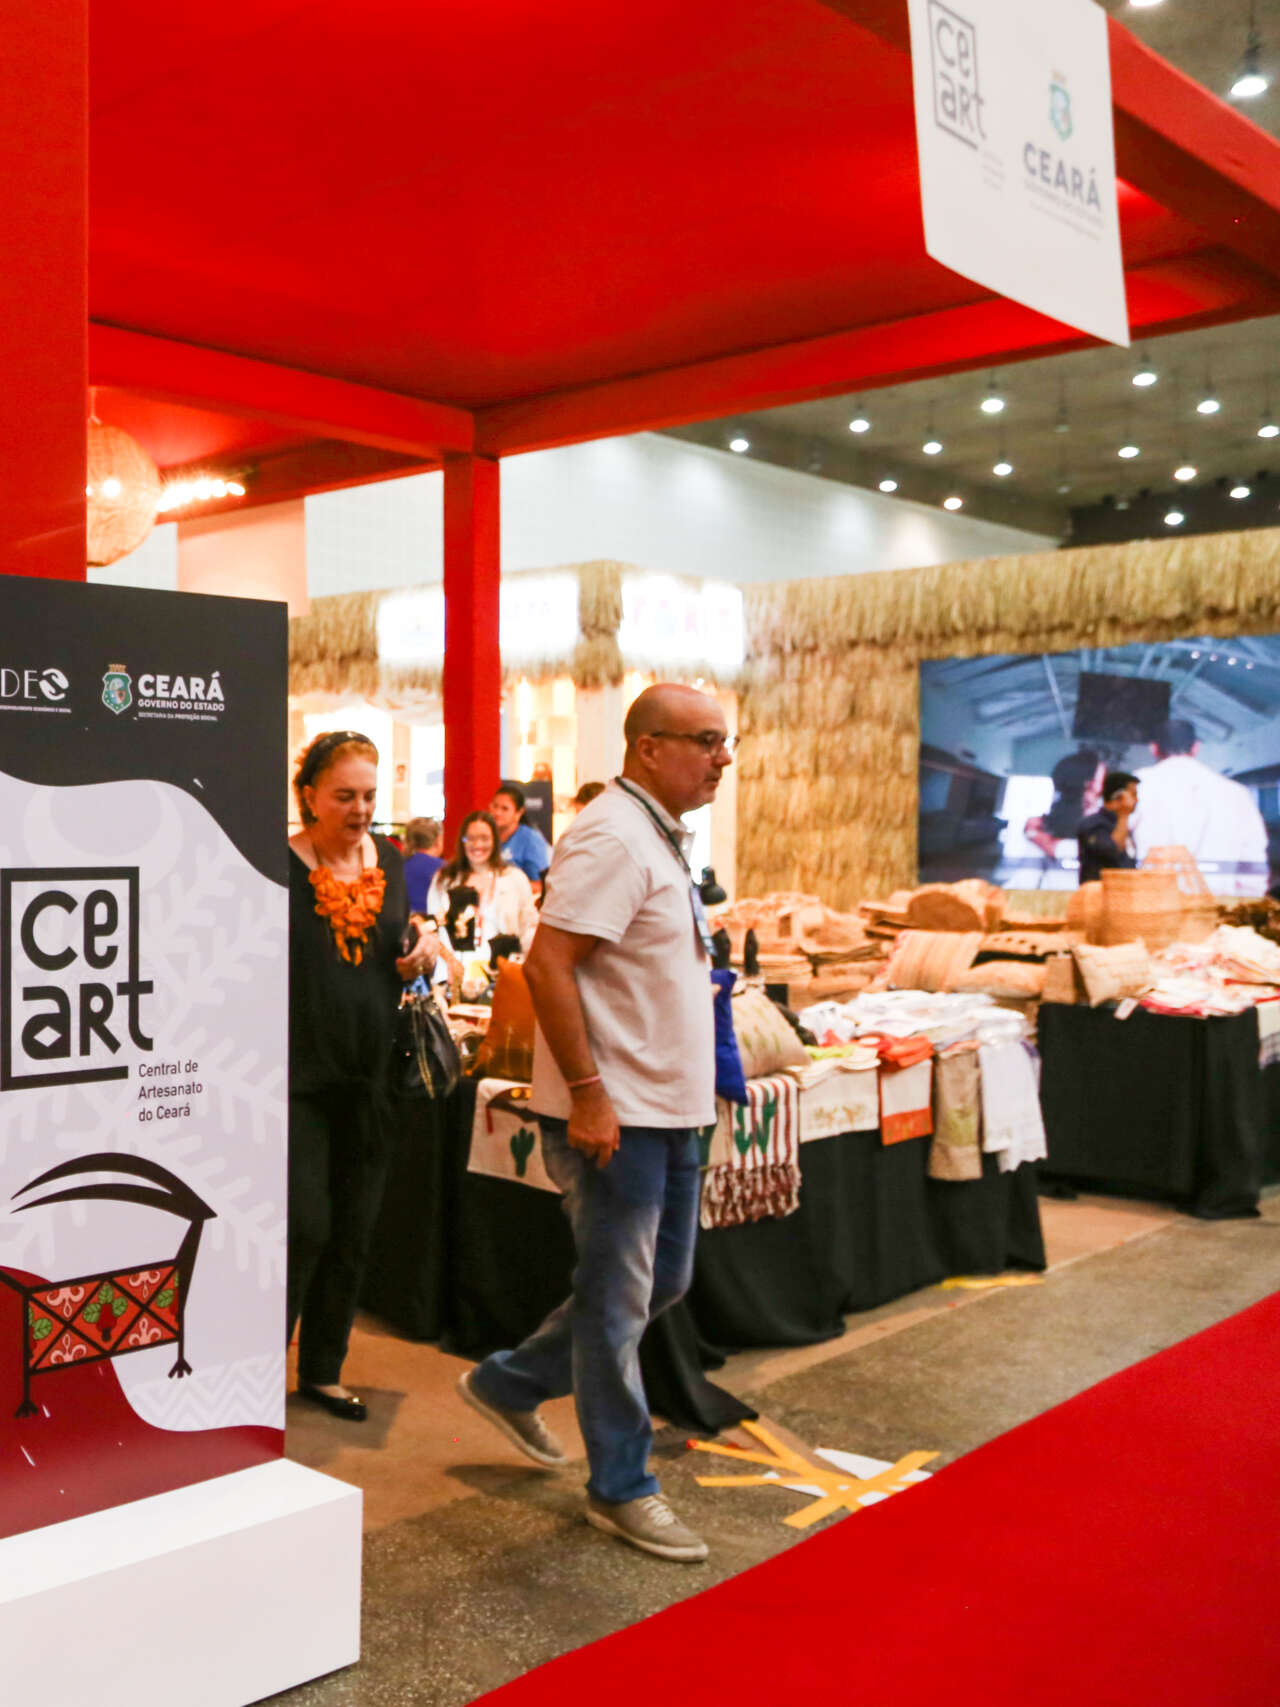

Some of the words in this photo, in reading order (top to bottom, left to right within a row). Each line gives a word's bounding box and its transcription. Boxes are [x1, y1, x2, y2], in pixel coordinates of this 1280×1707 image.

[1023, 141, 1102, 213] CEARÁ
[138, 671, 225, 702] CEARÁ
[138, 699, 178, 710] GOVERNO
[180, 701, 192, 710] DO
[193, 702, 225, 712] ESTADO
[138, 1060, 182, 1078] Central
[184, 1059, 199, 1073] de
[138, 1081, 203, 1100] Artesanato
[138, 1107, 153, 1122] do
[156, 1102, 191, 1120] Ceará
